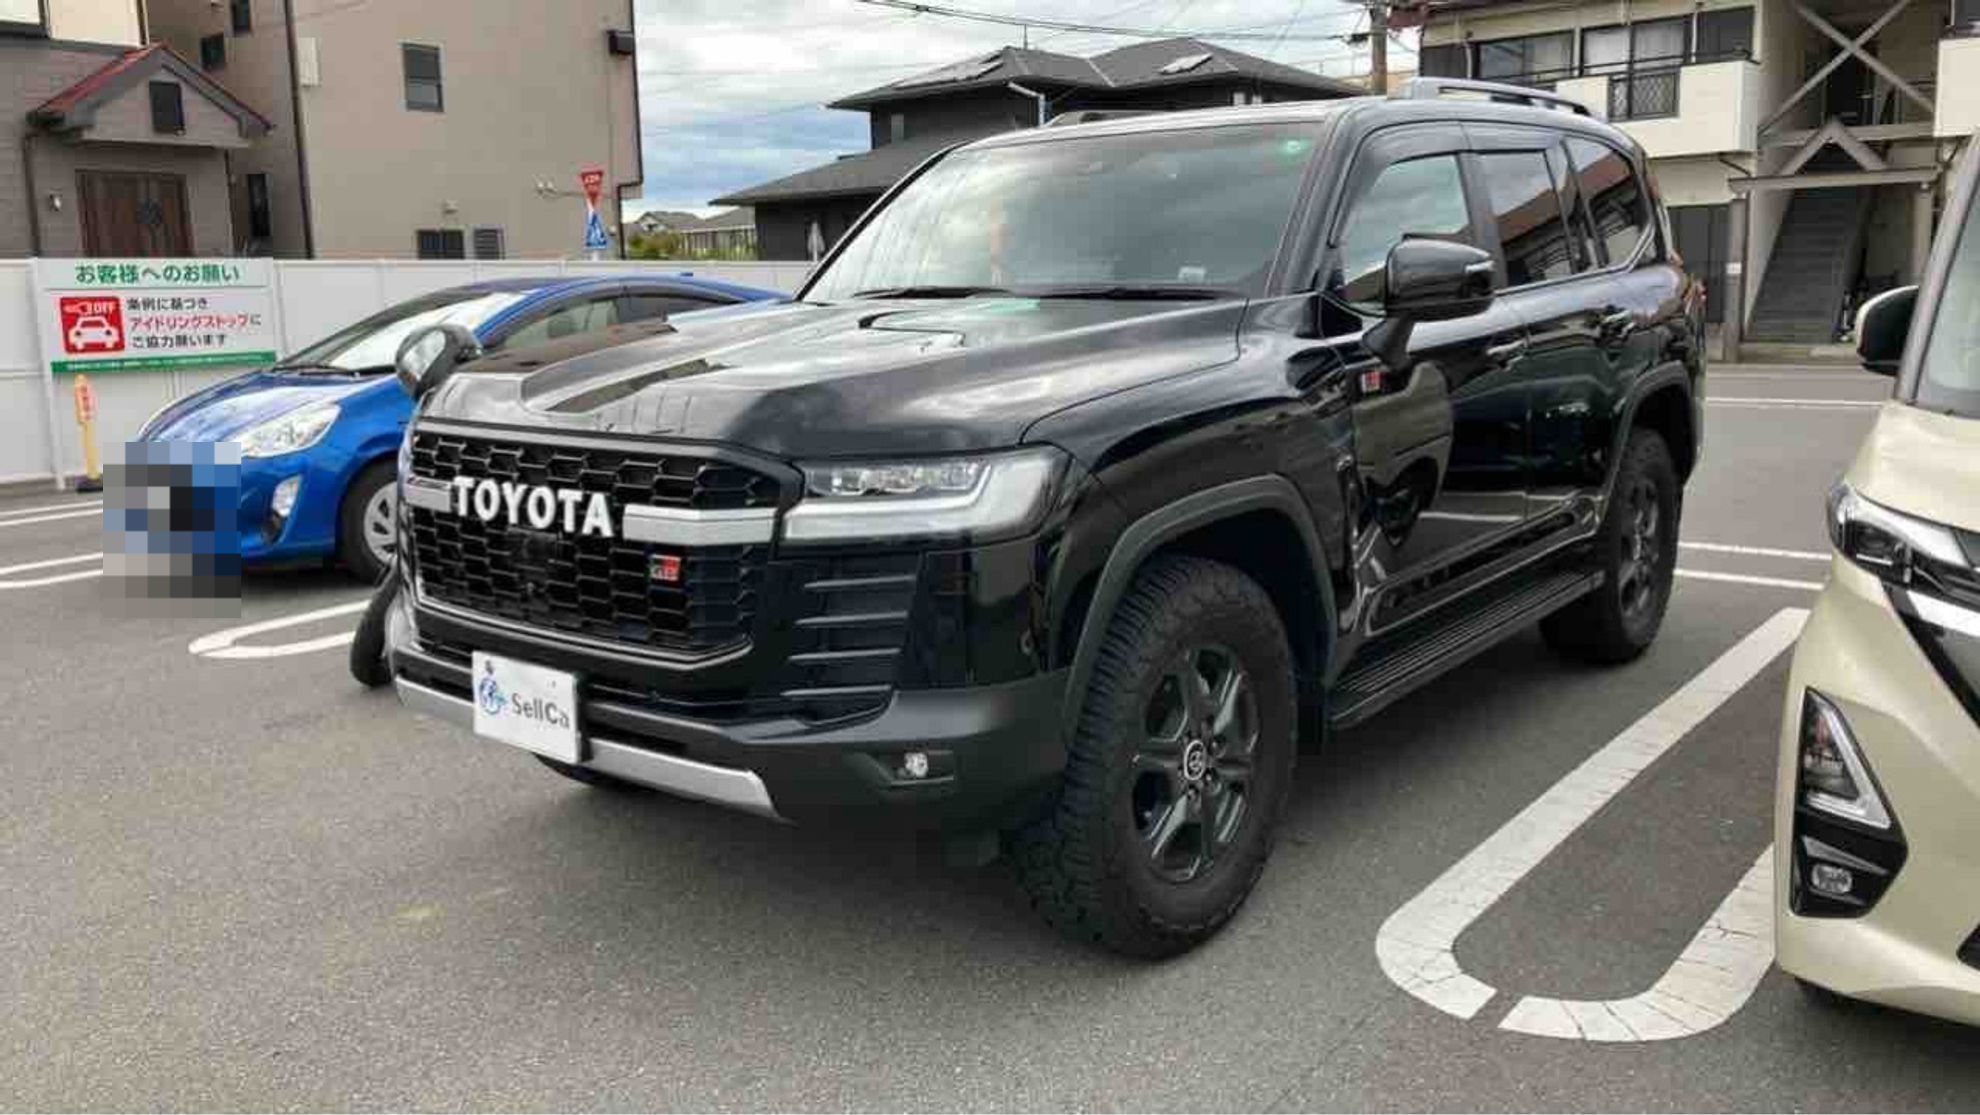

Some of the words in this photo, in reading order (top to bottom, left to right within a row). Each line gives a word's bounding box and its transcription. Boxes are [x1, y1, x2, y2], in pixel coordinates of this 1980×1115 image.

[75, 264, 240, 284] お客様へのお願い
[127, 297, 209, 311] 条例に基づき
[130, 314, 261, 331] アイドリングストップに
[453, 476, 614, 538] TOYOTA
[511, 692, 569, 729] SellCa
